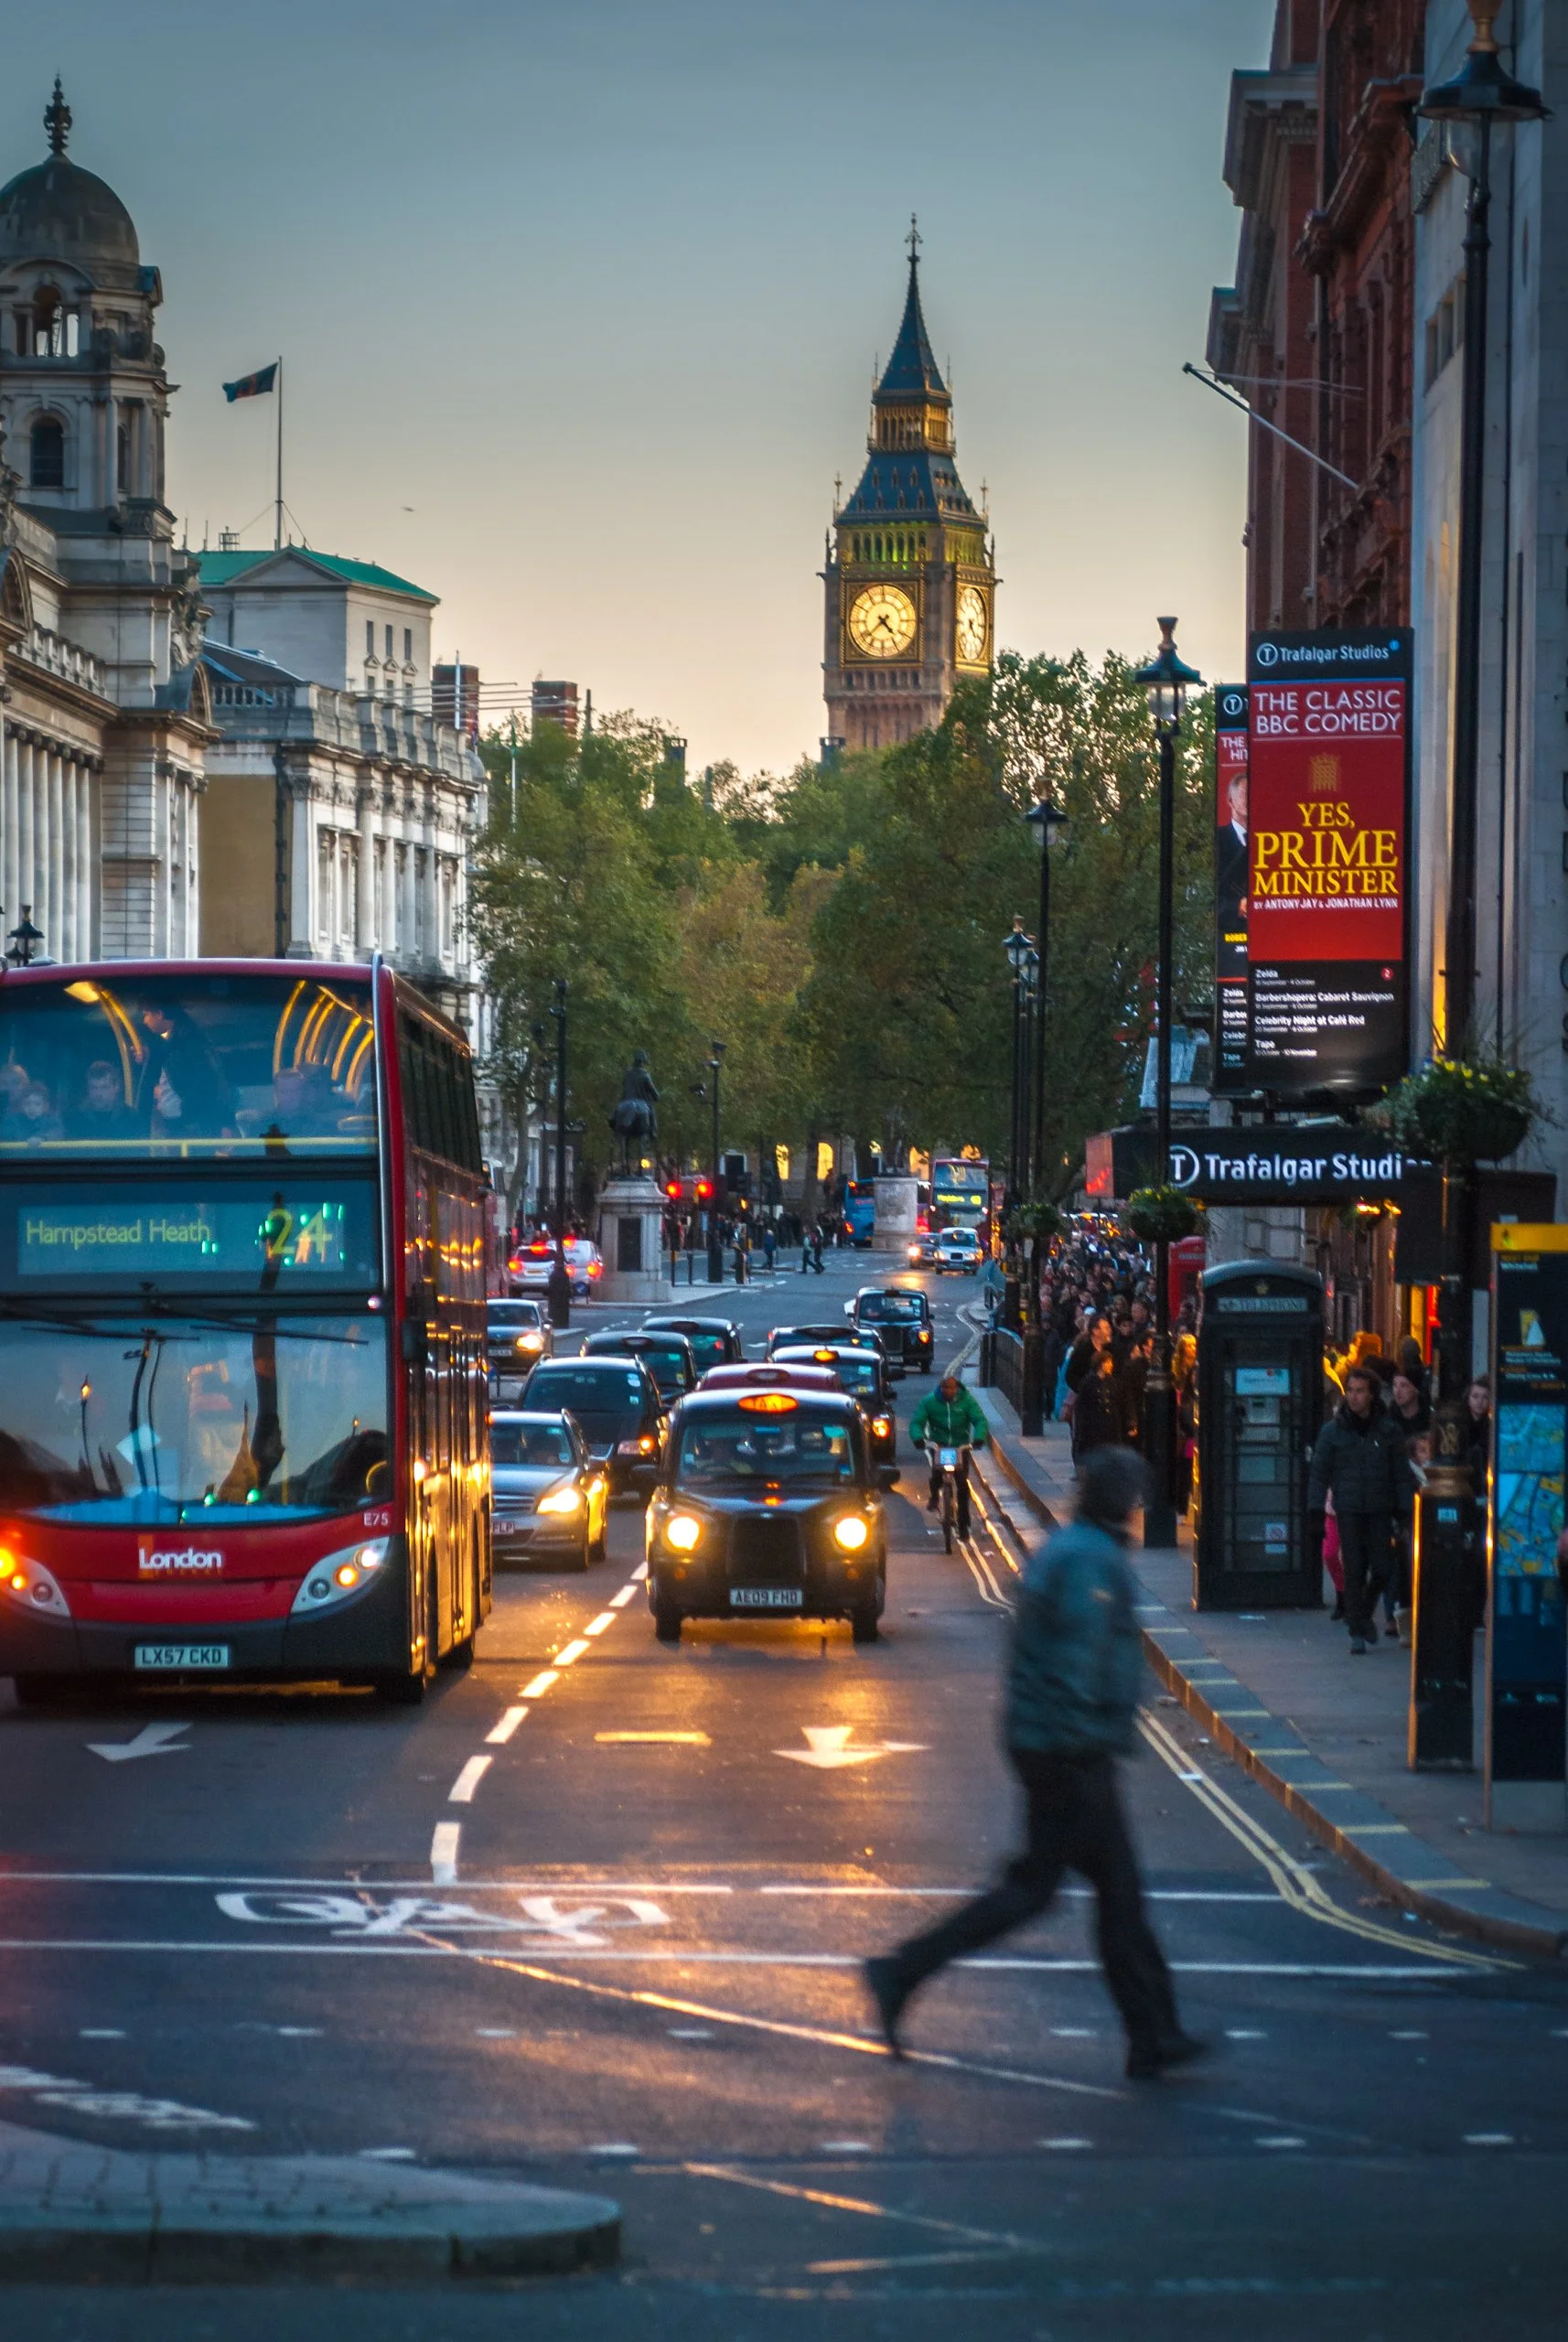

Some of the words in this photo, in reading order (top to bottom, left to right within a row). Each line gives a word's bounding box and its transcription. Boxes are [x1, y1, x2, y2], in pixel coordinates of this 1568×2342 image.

[1281, 647, 1337, 663] Trafalgar
[1340, 644, 1389, 661] Studios
[1254, 692, 1297, 712] THE
[1305, 690, 1401, 711] CLASSIC
[1256, 714, 1299, 734] BBC
[1305, 712, 1402, 733] COMEDY
[1220, 736, 1245, 748] THE
[1296, 801, 1355, 829] YES,
[1253, 830, 1398, 869] PRIME
[1252, 869, 1399, 896] MINISTER
[1300, 898, 1317, 908] JAY
[1325, 897, 1372, 908] JONATHAN
[1373, 897, 1398, 908] LYNN
[1204, 1153, 1326, 1186] Trafalgar
[1332, 1153, 1433, 1180] Studi
[26, 1219, 142, 1251] Hampstead
[149, 1217, 210, 1242] Heath
[266, 1209, 333, 1256] 24
[363, 1512, 389, 1526] E75
[138, 1547, 221, 1569] London
[142, 1649, 184, 1664] LX57
[189, 1648, 221, 1663] CKD
